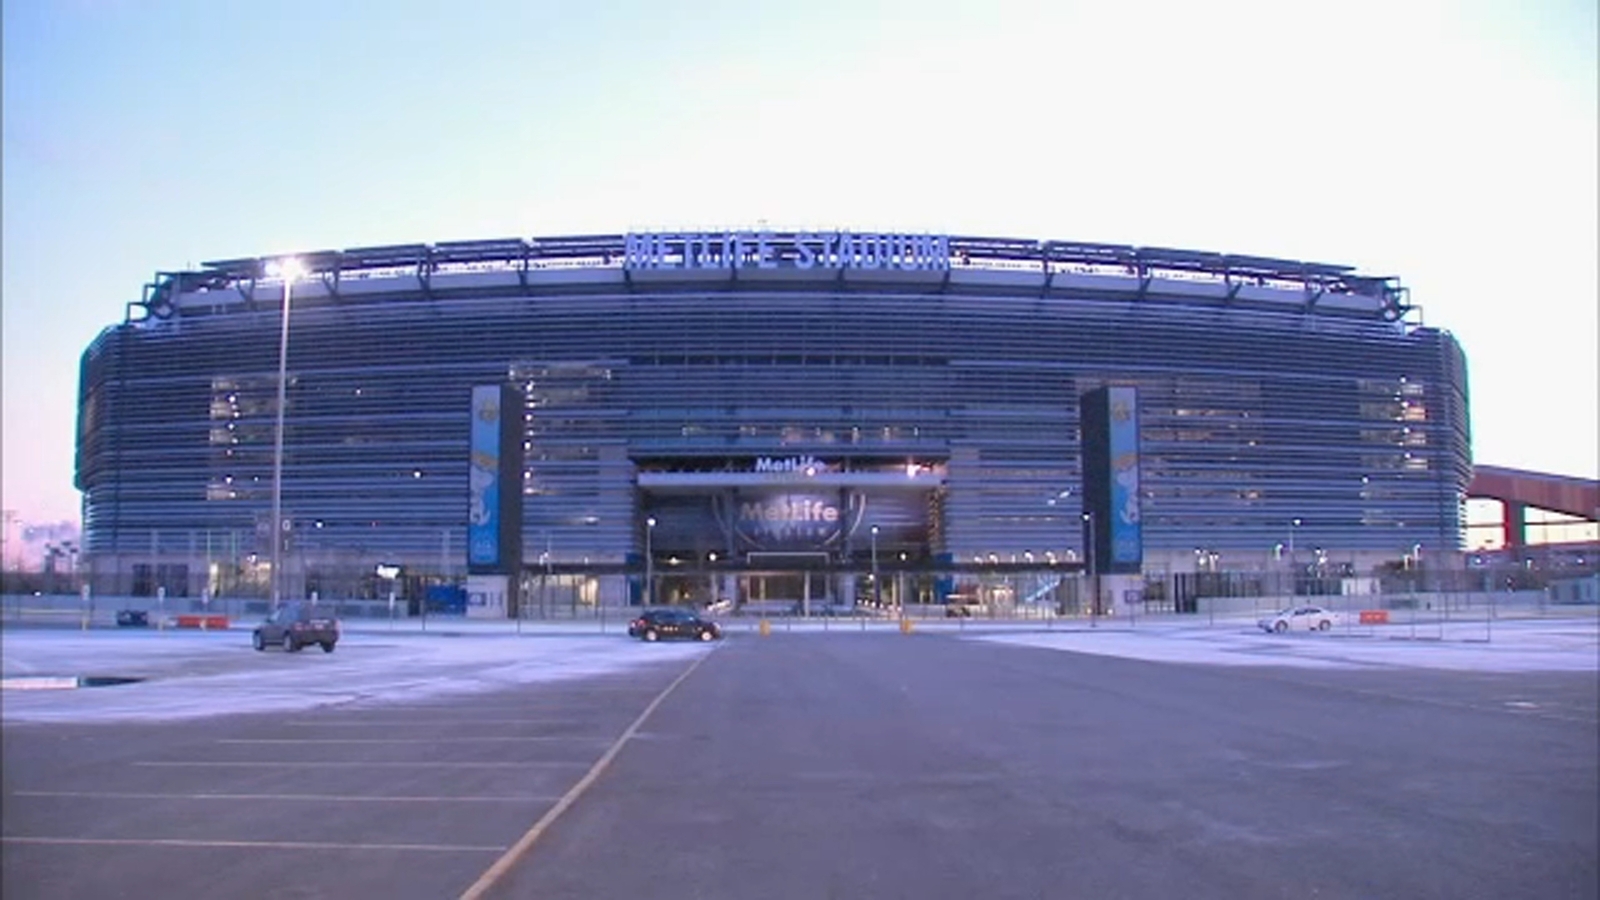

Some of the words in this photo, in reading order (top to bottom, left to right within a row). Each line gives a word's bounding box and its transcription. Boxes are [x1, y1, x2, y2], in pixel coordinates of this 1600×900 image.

[626, 232, 777, 270] METLIFE
[795, 232, 950, 271] STADIUM
[755, 455, 826, 472] MetLife
[740, 500, 840, 521] MetLife
